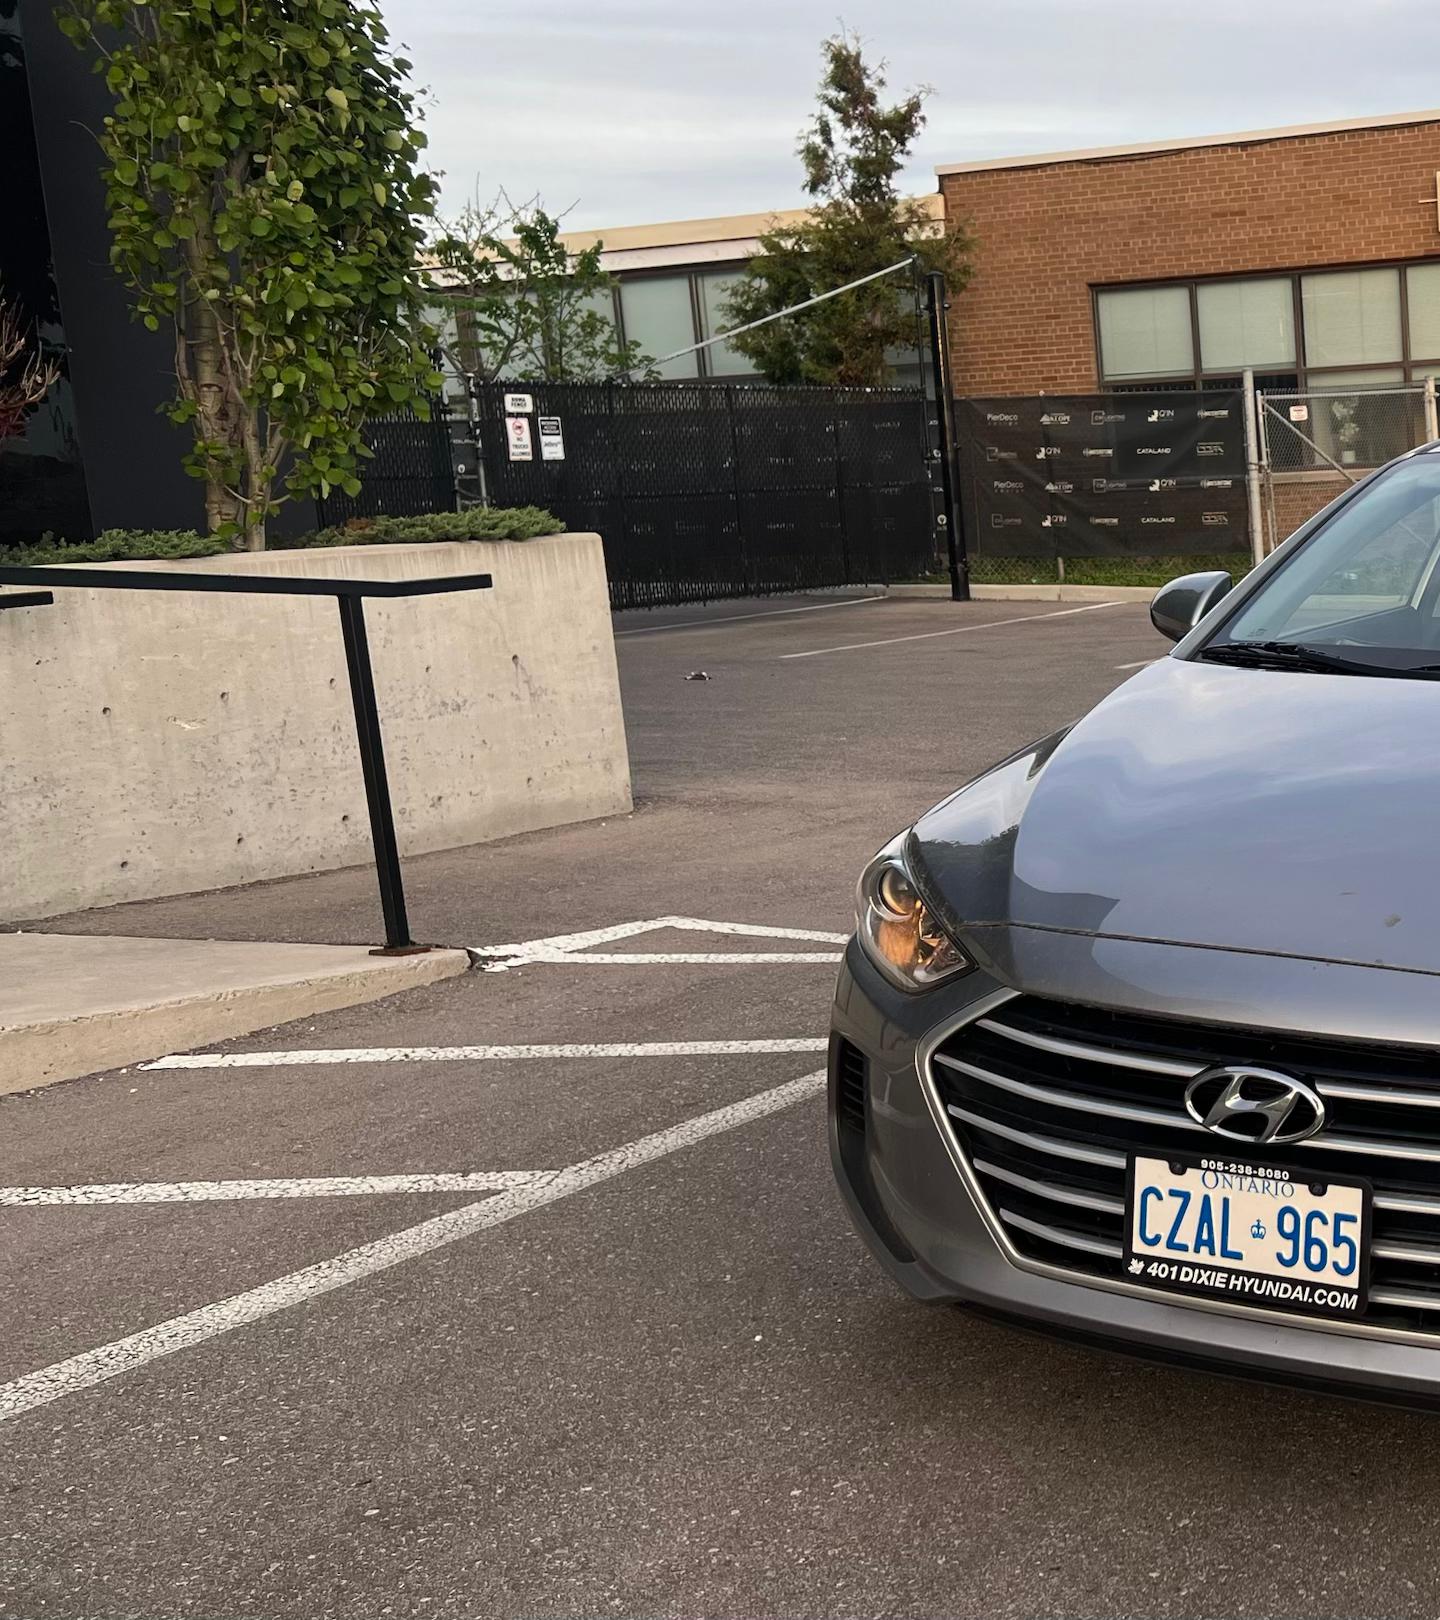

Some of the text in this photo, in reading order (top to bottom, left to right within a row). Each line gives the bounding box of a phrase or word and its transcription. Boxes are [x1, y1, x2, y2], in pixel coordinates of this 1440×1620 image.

[1200, 1159, 1290, 1181] 905-238-8080
[1138, 1186, 1358, 1277] CZAL 965
[1147, 1262, 1359, 1311] 401 DIXIE HYUNDAI.COM
